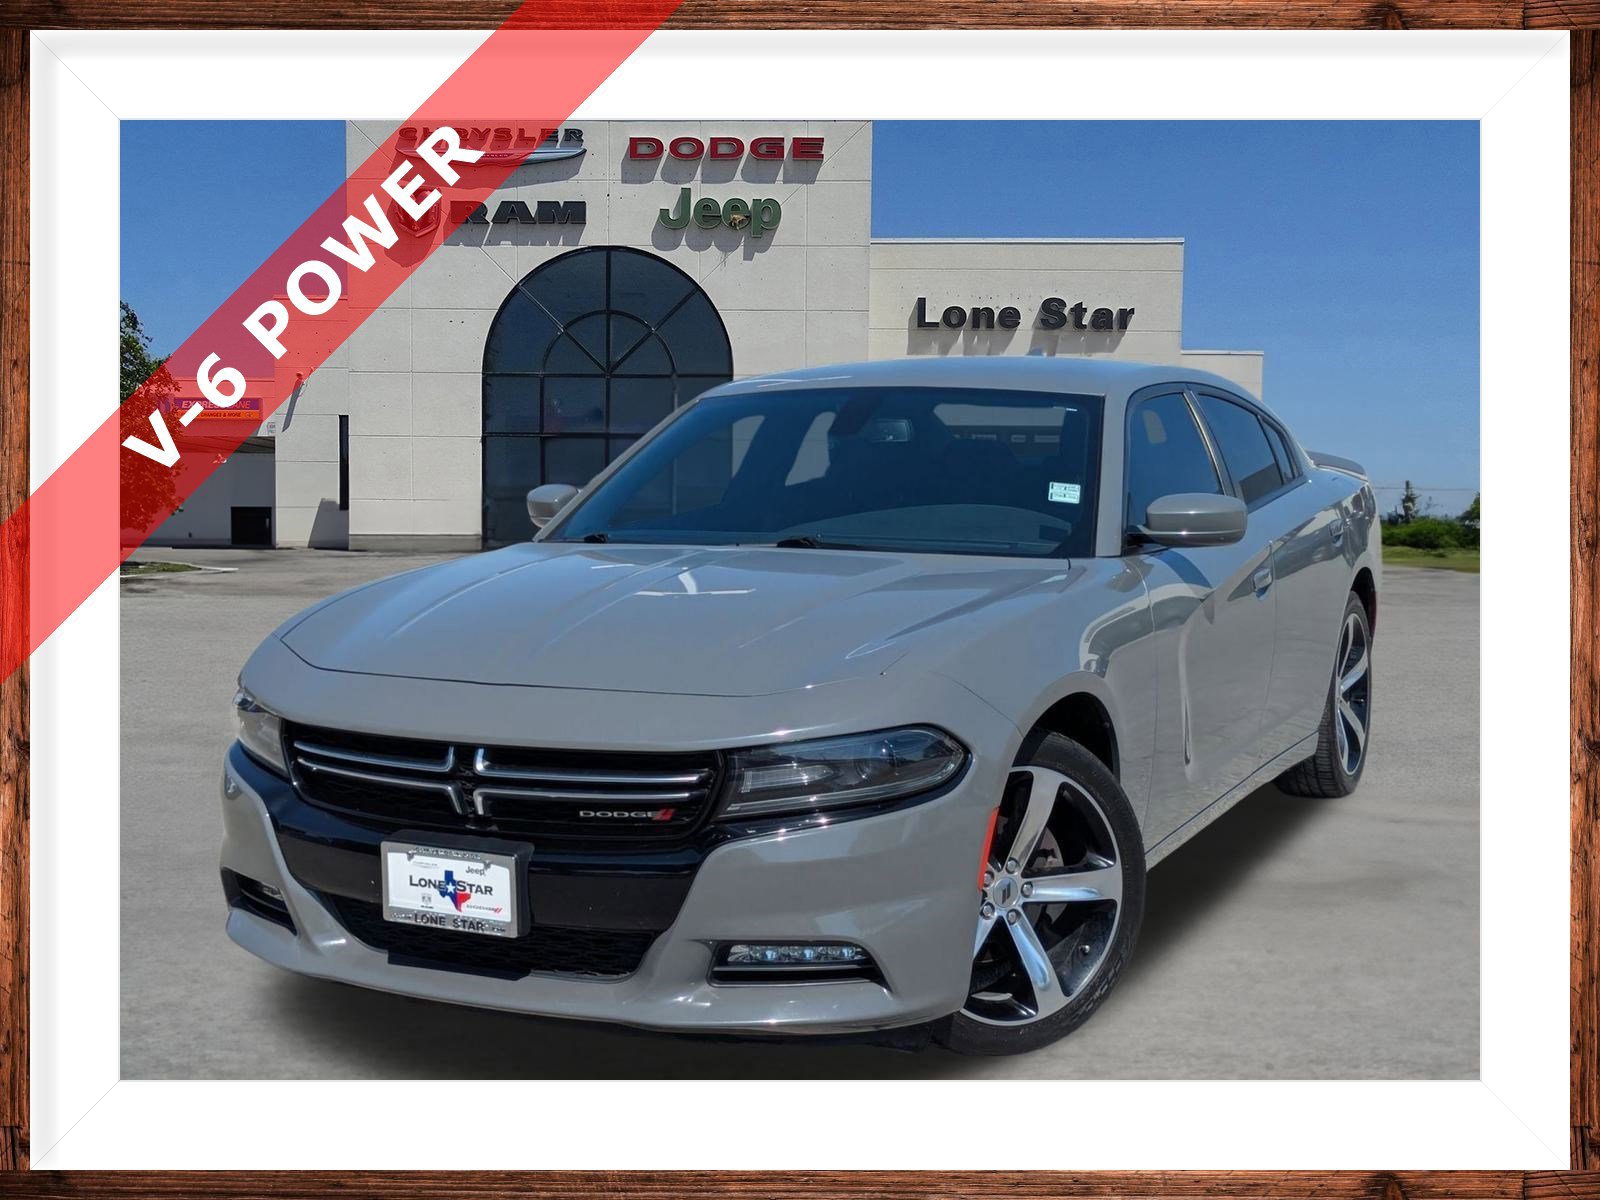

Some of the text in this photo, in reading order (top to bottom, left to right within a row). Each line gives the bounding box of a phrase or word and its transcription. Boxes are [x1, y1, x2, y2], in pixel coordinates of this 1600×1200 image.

[629, 136, 825, 160] DODGE
[450, 200, 587, 225] RAM
[659, 187, 782, 238] Jeep
[917, 297, 1135, 330] Lone Star
[579, 810, 660, 819] DODGE
[465, 866, 485, 876] Jeep
[409, 875, 493, 896] LONE STAR
[414, 913, 446, 926] LONE
[452, 918, 485, 932] STAR
